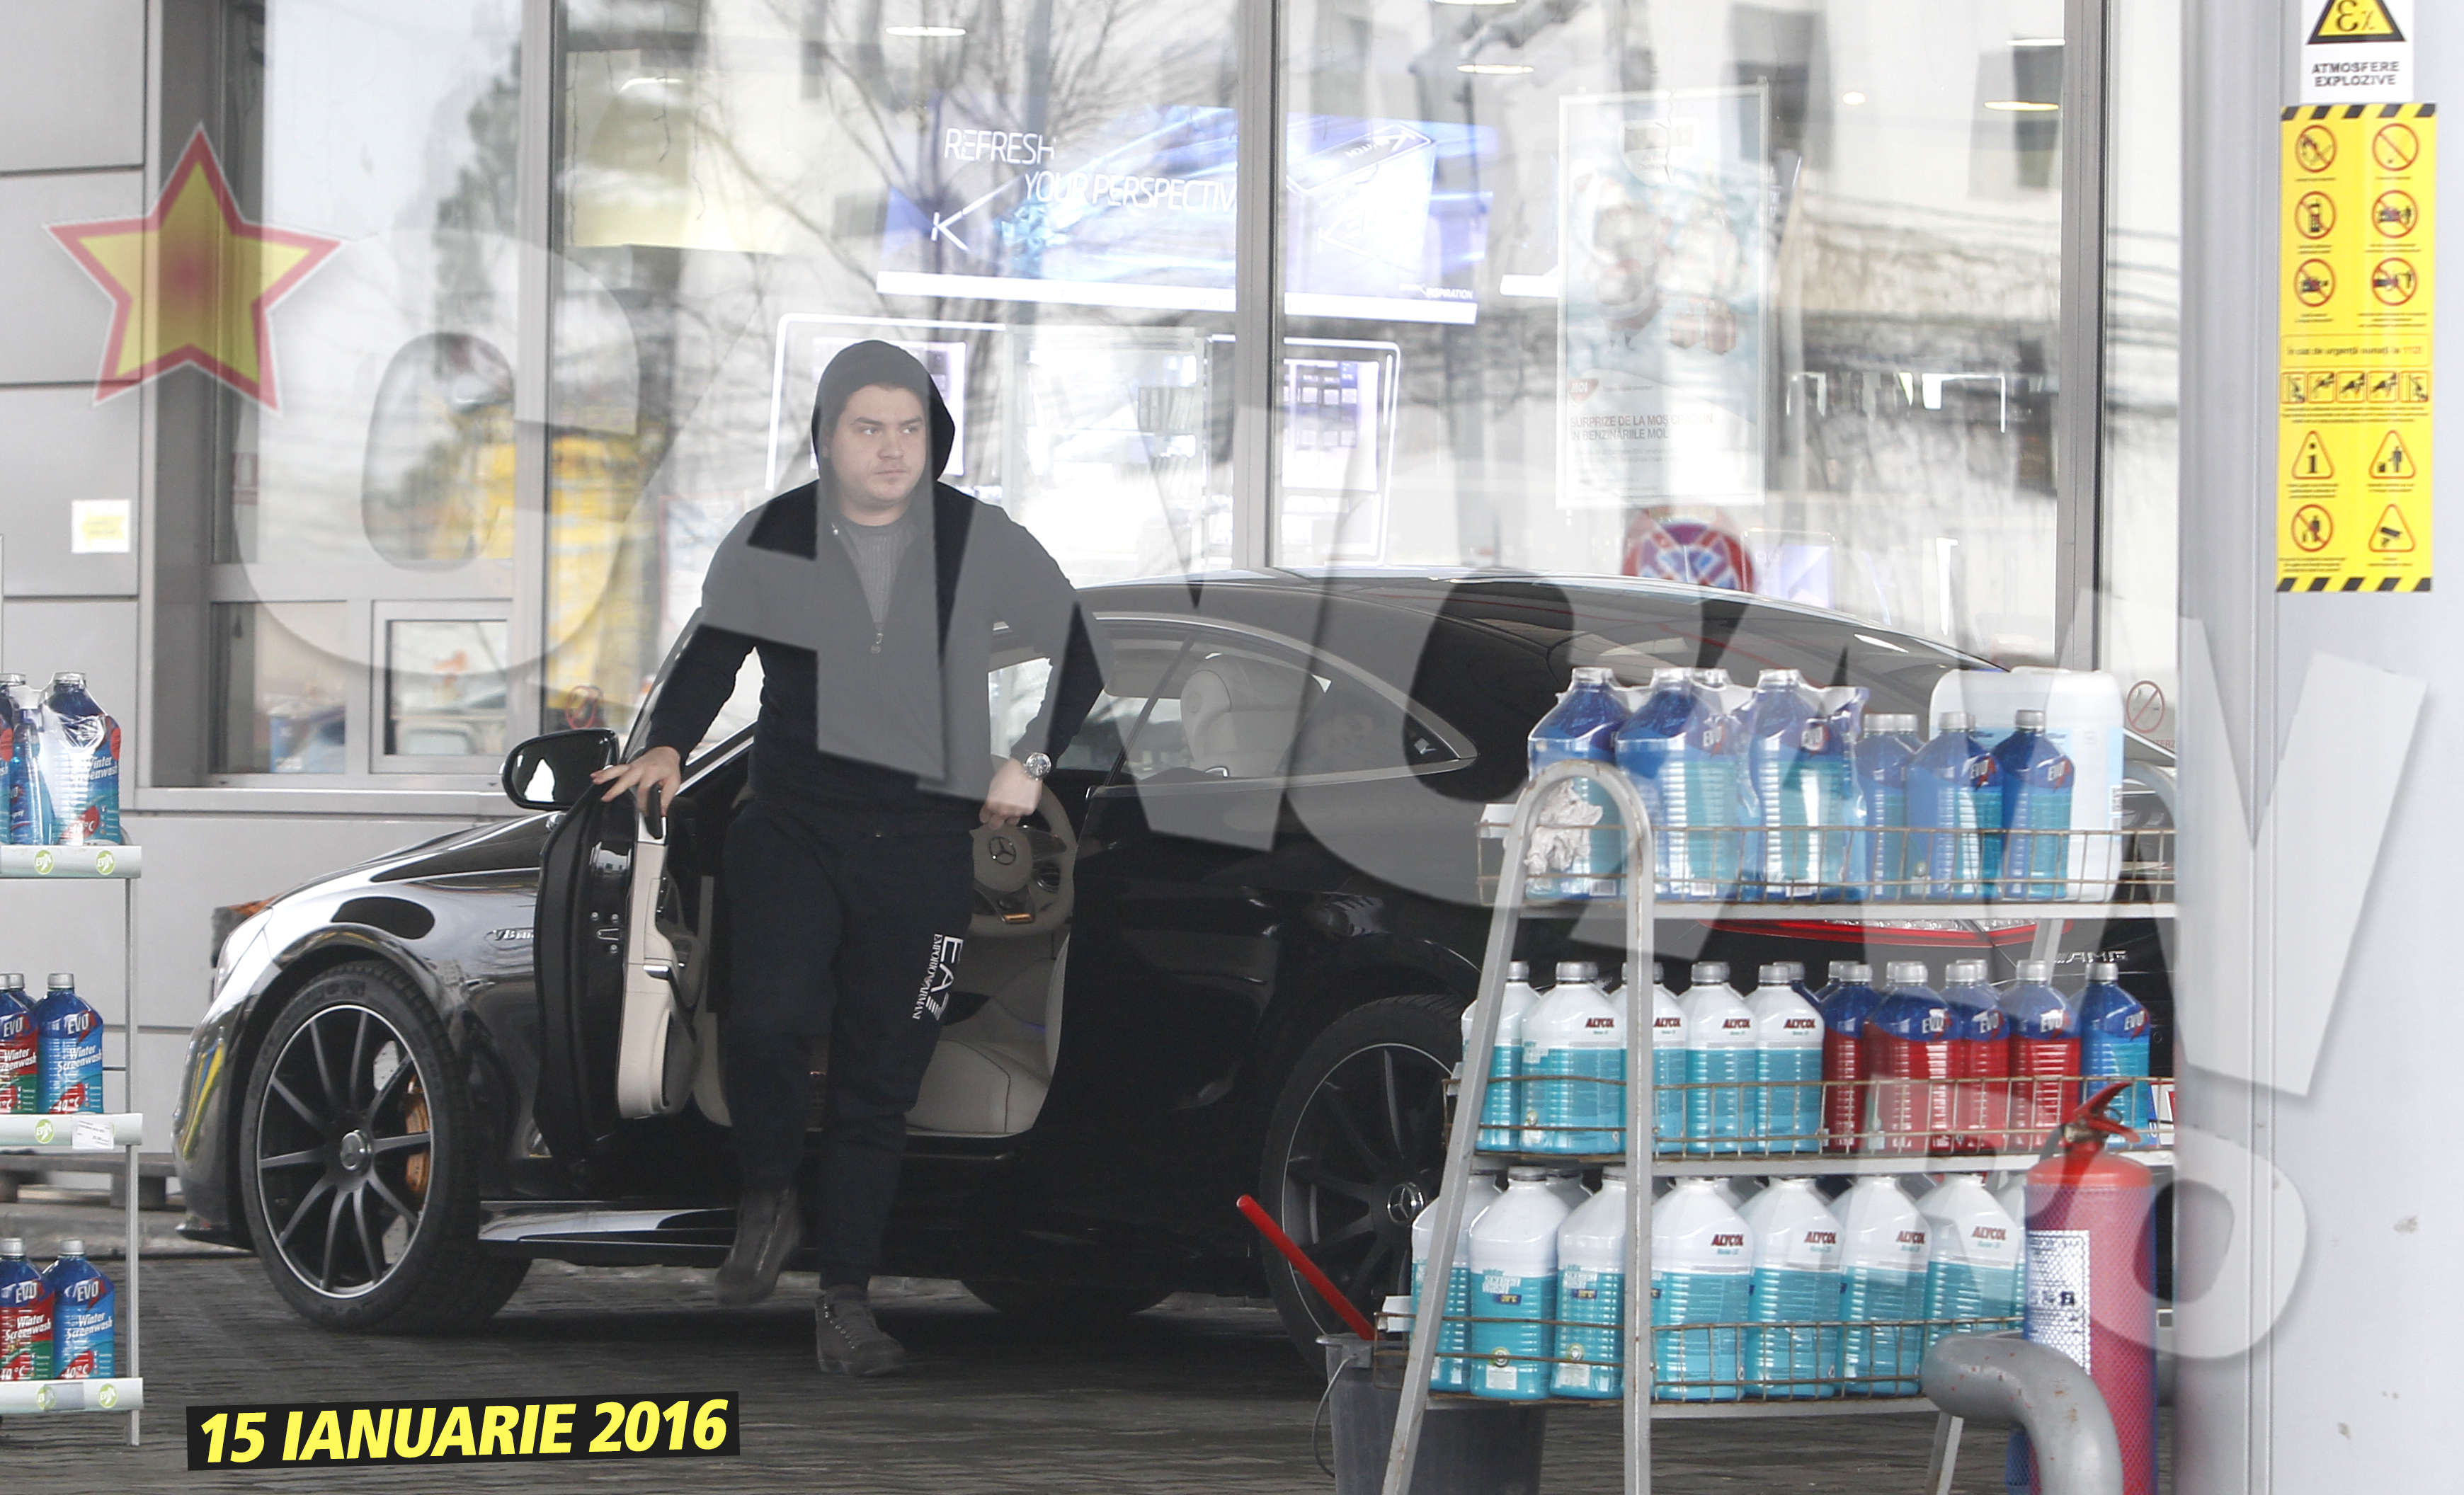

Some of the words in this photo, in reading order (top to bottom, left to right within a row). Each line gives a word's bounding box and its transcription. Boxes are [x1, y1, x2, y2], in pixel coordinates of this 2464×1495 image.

[2311, 60, 2400, 75] ATMOSFERE
[2314, 74, 2397, 88] EXPLOZIVE
[944, 128, 1056, 166] REFRESH
[1025, 171, 1088, 203] YOUR
[1570, 415, 1616, 428] SURPRIZE
[1618, 415, 1631, 426] DE
[1633, 414, 1645, 425] LA
[1647, 428, 1669, 439] MOL
[927, 933, 943, 977] EMPORIO
[925, 935, 964, 1021] EA7
[912, 983, 932, 1020] ARMANI
[2, 1016, 24, 1038] EVO
[67, 1013, 90, 1036] EVO
[1585, 1017, 1615, 1028] ALYCOL
[1653, 1017, 1682, 1028] ALYCOL
[1722, 1018, 1751, 1029] ALYCOL
[1783, 1018, 1816, 1029] ALYCOL
[4, 1048, 30, 1062] Winter
[57, 1050, 102, 1073] Screenwash
[1711, 1234, 1744, 1247] ALYCOL
[1805, 1231, 1837, 1244] ALYCOL
[1895, 1230, 1926, 1244] ALYCOL
[1971, 1225, 2007, 1241] ALYCOL
[16, 1281, 38, 1304] EVO
[76, 1281, 99, 1302] EVO
[16, 1314, 45, 1329] Winter
[78, 1312, 105, 1327] Winter
[5, 1319, 52, 1341] Screenwash
[66, 1317, 113, 1340] Screenwash
